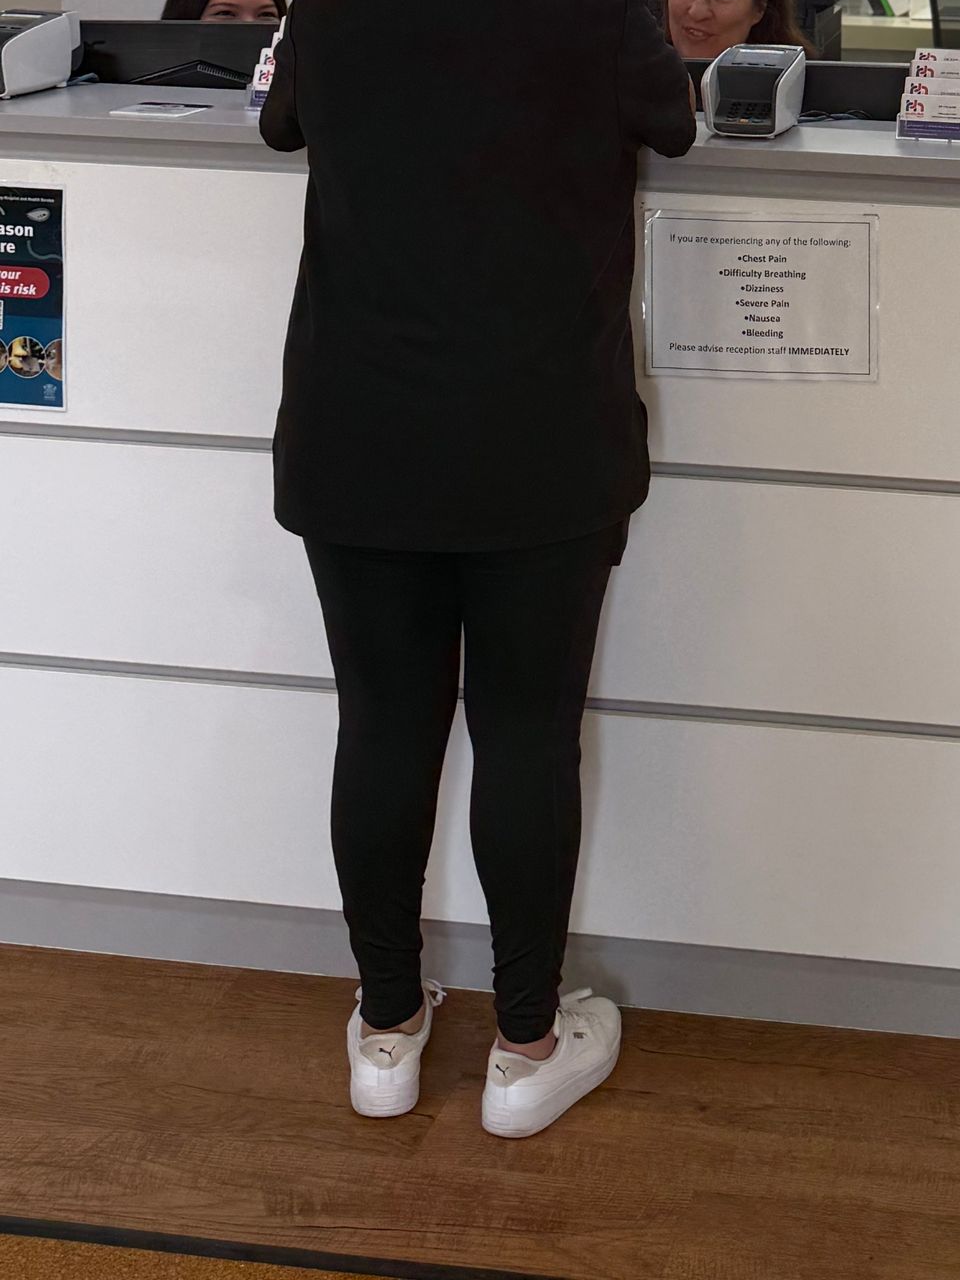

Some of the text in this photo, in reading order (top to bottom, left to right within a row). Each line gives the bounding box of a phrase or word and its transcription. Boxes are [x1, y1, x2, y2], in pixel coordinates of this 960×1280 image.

[669, 233, 676, 242] If
[677, 236, 693, 244] you
[710, 237, 763, 247] experiencing
[765, 238, 780, 247] any
[783, 237, 792, 246] of
[793, 237, 808, 246] the
[810, 237, 851, 248] following:
[0, 242, 16, 253] re
[742, 254, 787, 263] Chest Pain
[0, 271, 21, 280] our
[723, 268, 807, 280] Difficulty Breathing
[0, 282, 37, 296] is risk
[745, 284, 784, 293] Dizziness
[740, 299, 790, 308] Severe Pain
[748, 314, 781, 322] Nausea
[746, 328, 784, 339] Bleeding
[669, 342, 850, 356] Please advise reception staff IMMEDIATELY
